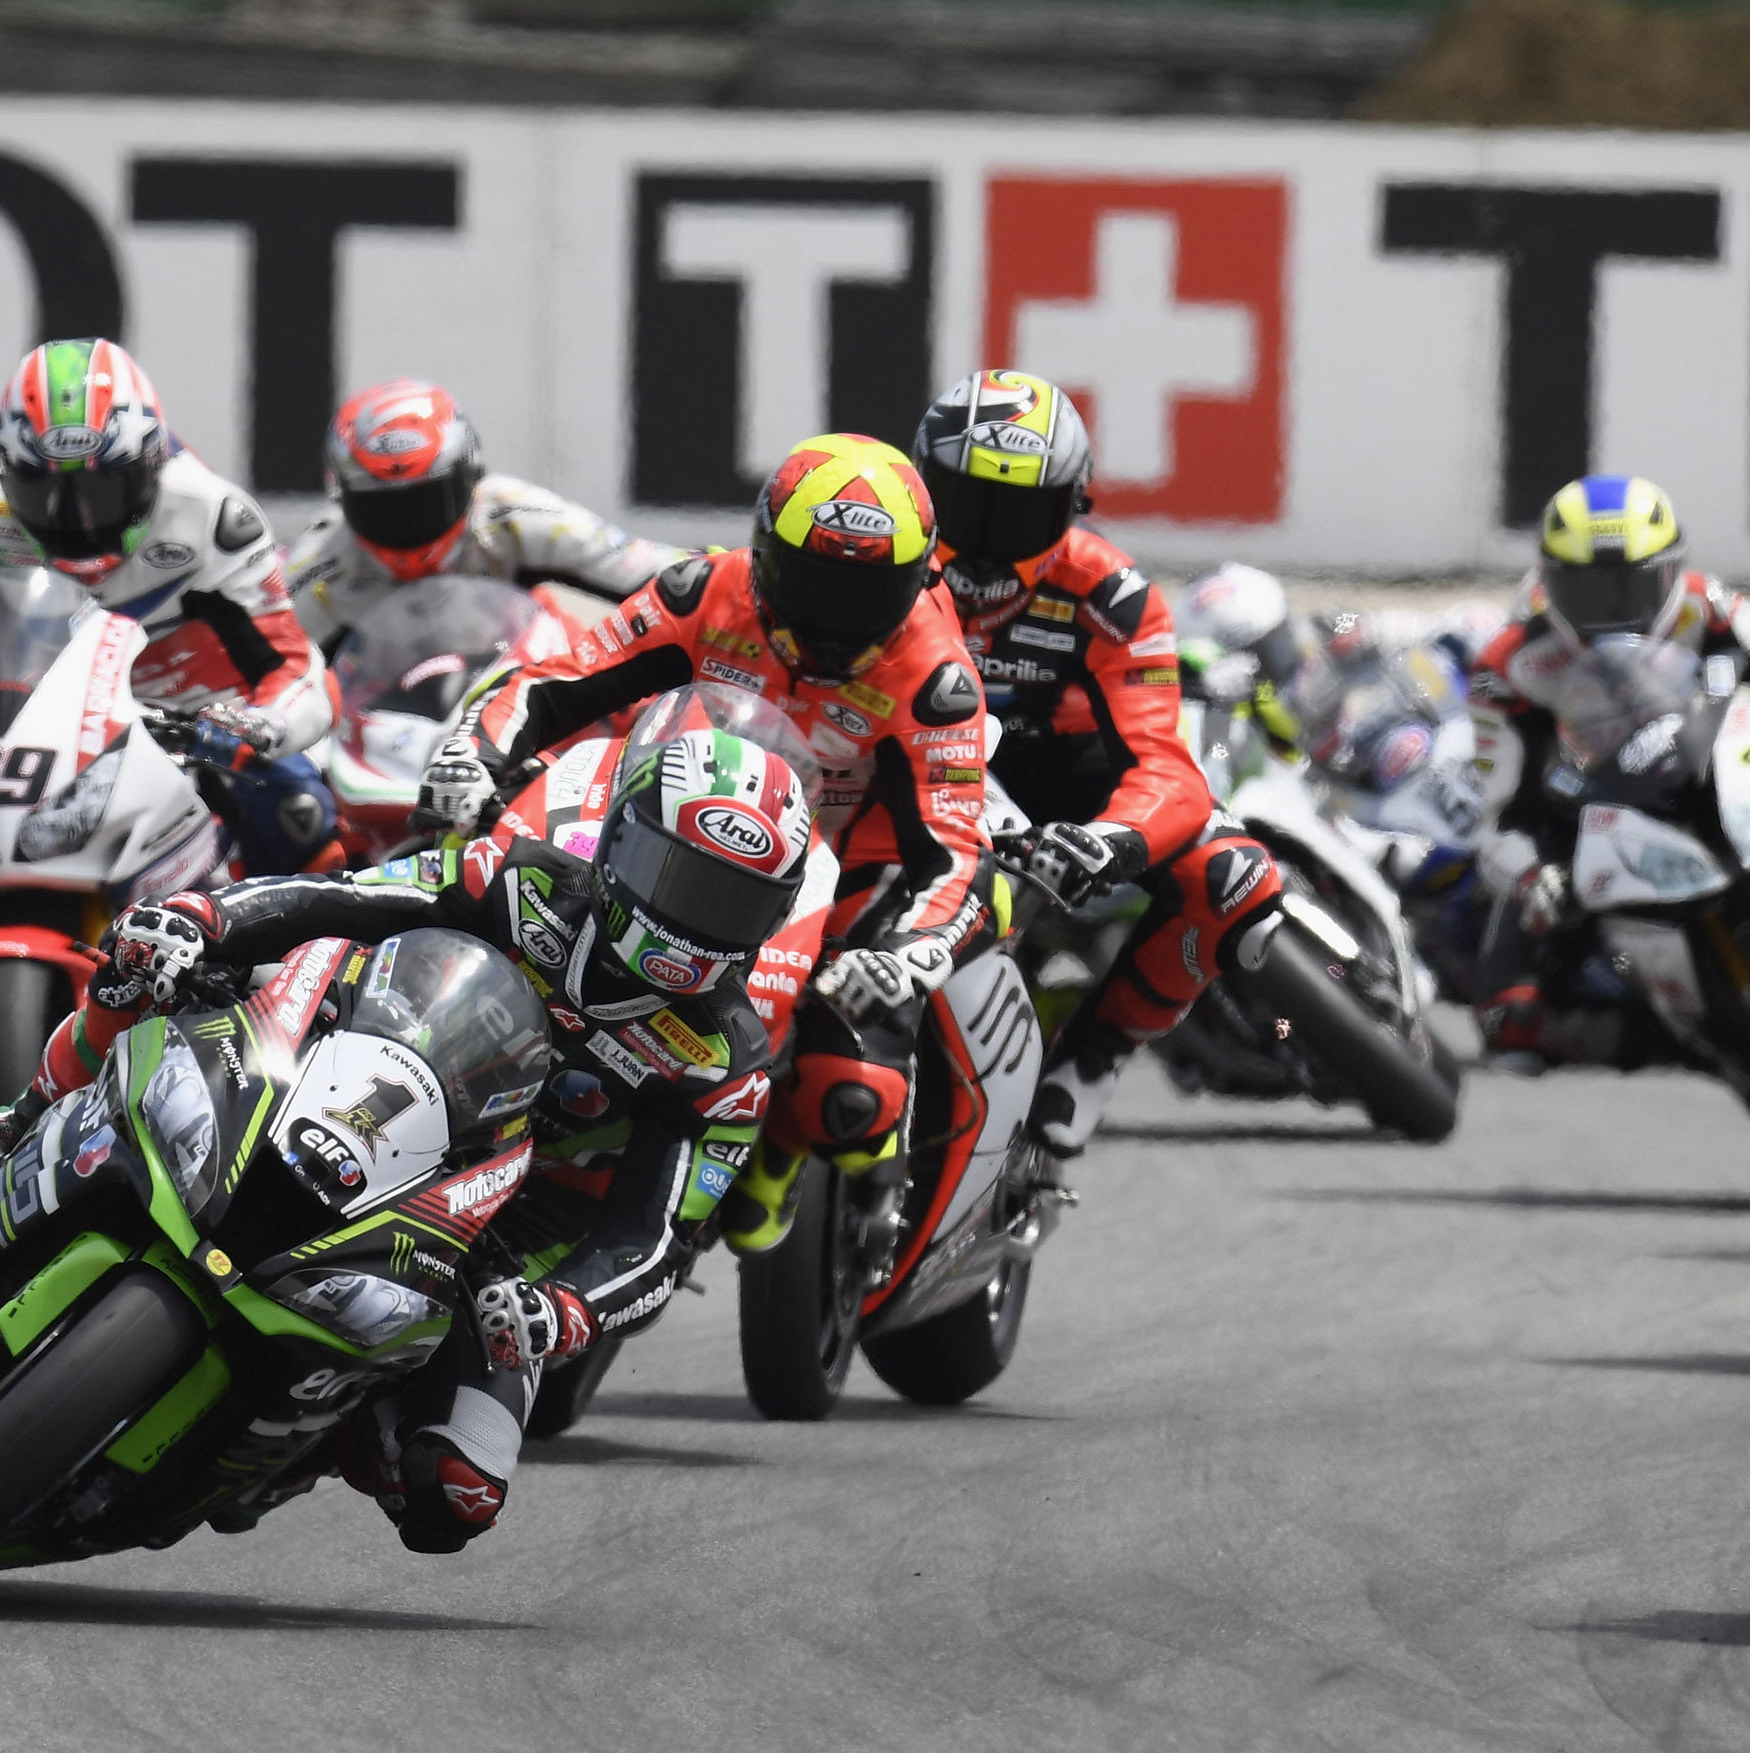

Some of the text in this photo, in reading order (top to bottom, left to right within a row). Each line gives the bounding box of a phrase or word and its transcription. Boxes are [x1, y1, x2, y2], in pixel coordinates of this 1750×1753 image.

[926, 745, 981, 763] MOTU
[704, 813, 765, 849] Arai
[631, 905, 746, 962] www.jonathan-rea.com
[649, 959, 686, 984] PATA
[657, 1013, 713, 1065] PIRELLI
[220, 1036, 249, 1091] MONSTER
[379, 1043, 440, 1107] Kawasaki
[610, 1048, 645, 1081] J.JUAN
[320, 1072, 420, 1168] 1
[299, 1128, 350, 1163] elf
[412, 1249, 456, 1281] MONSTER
